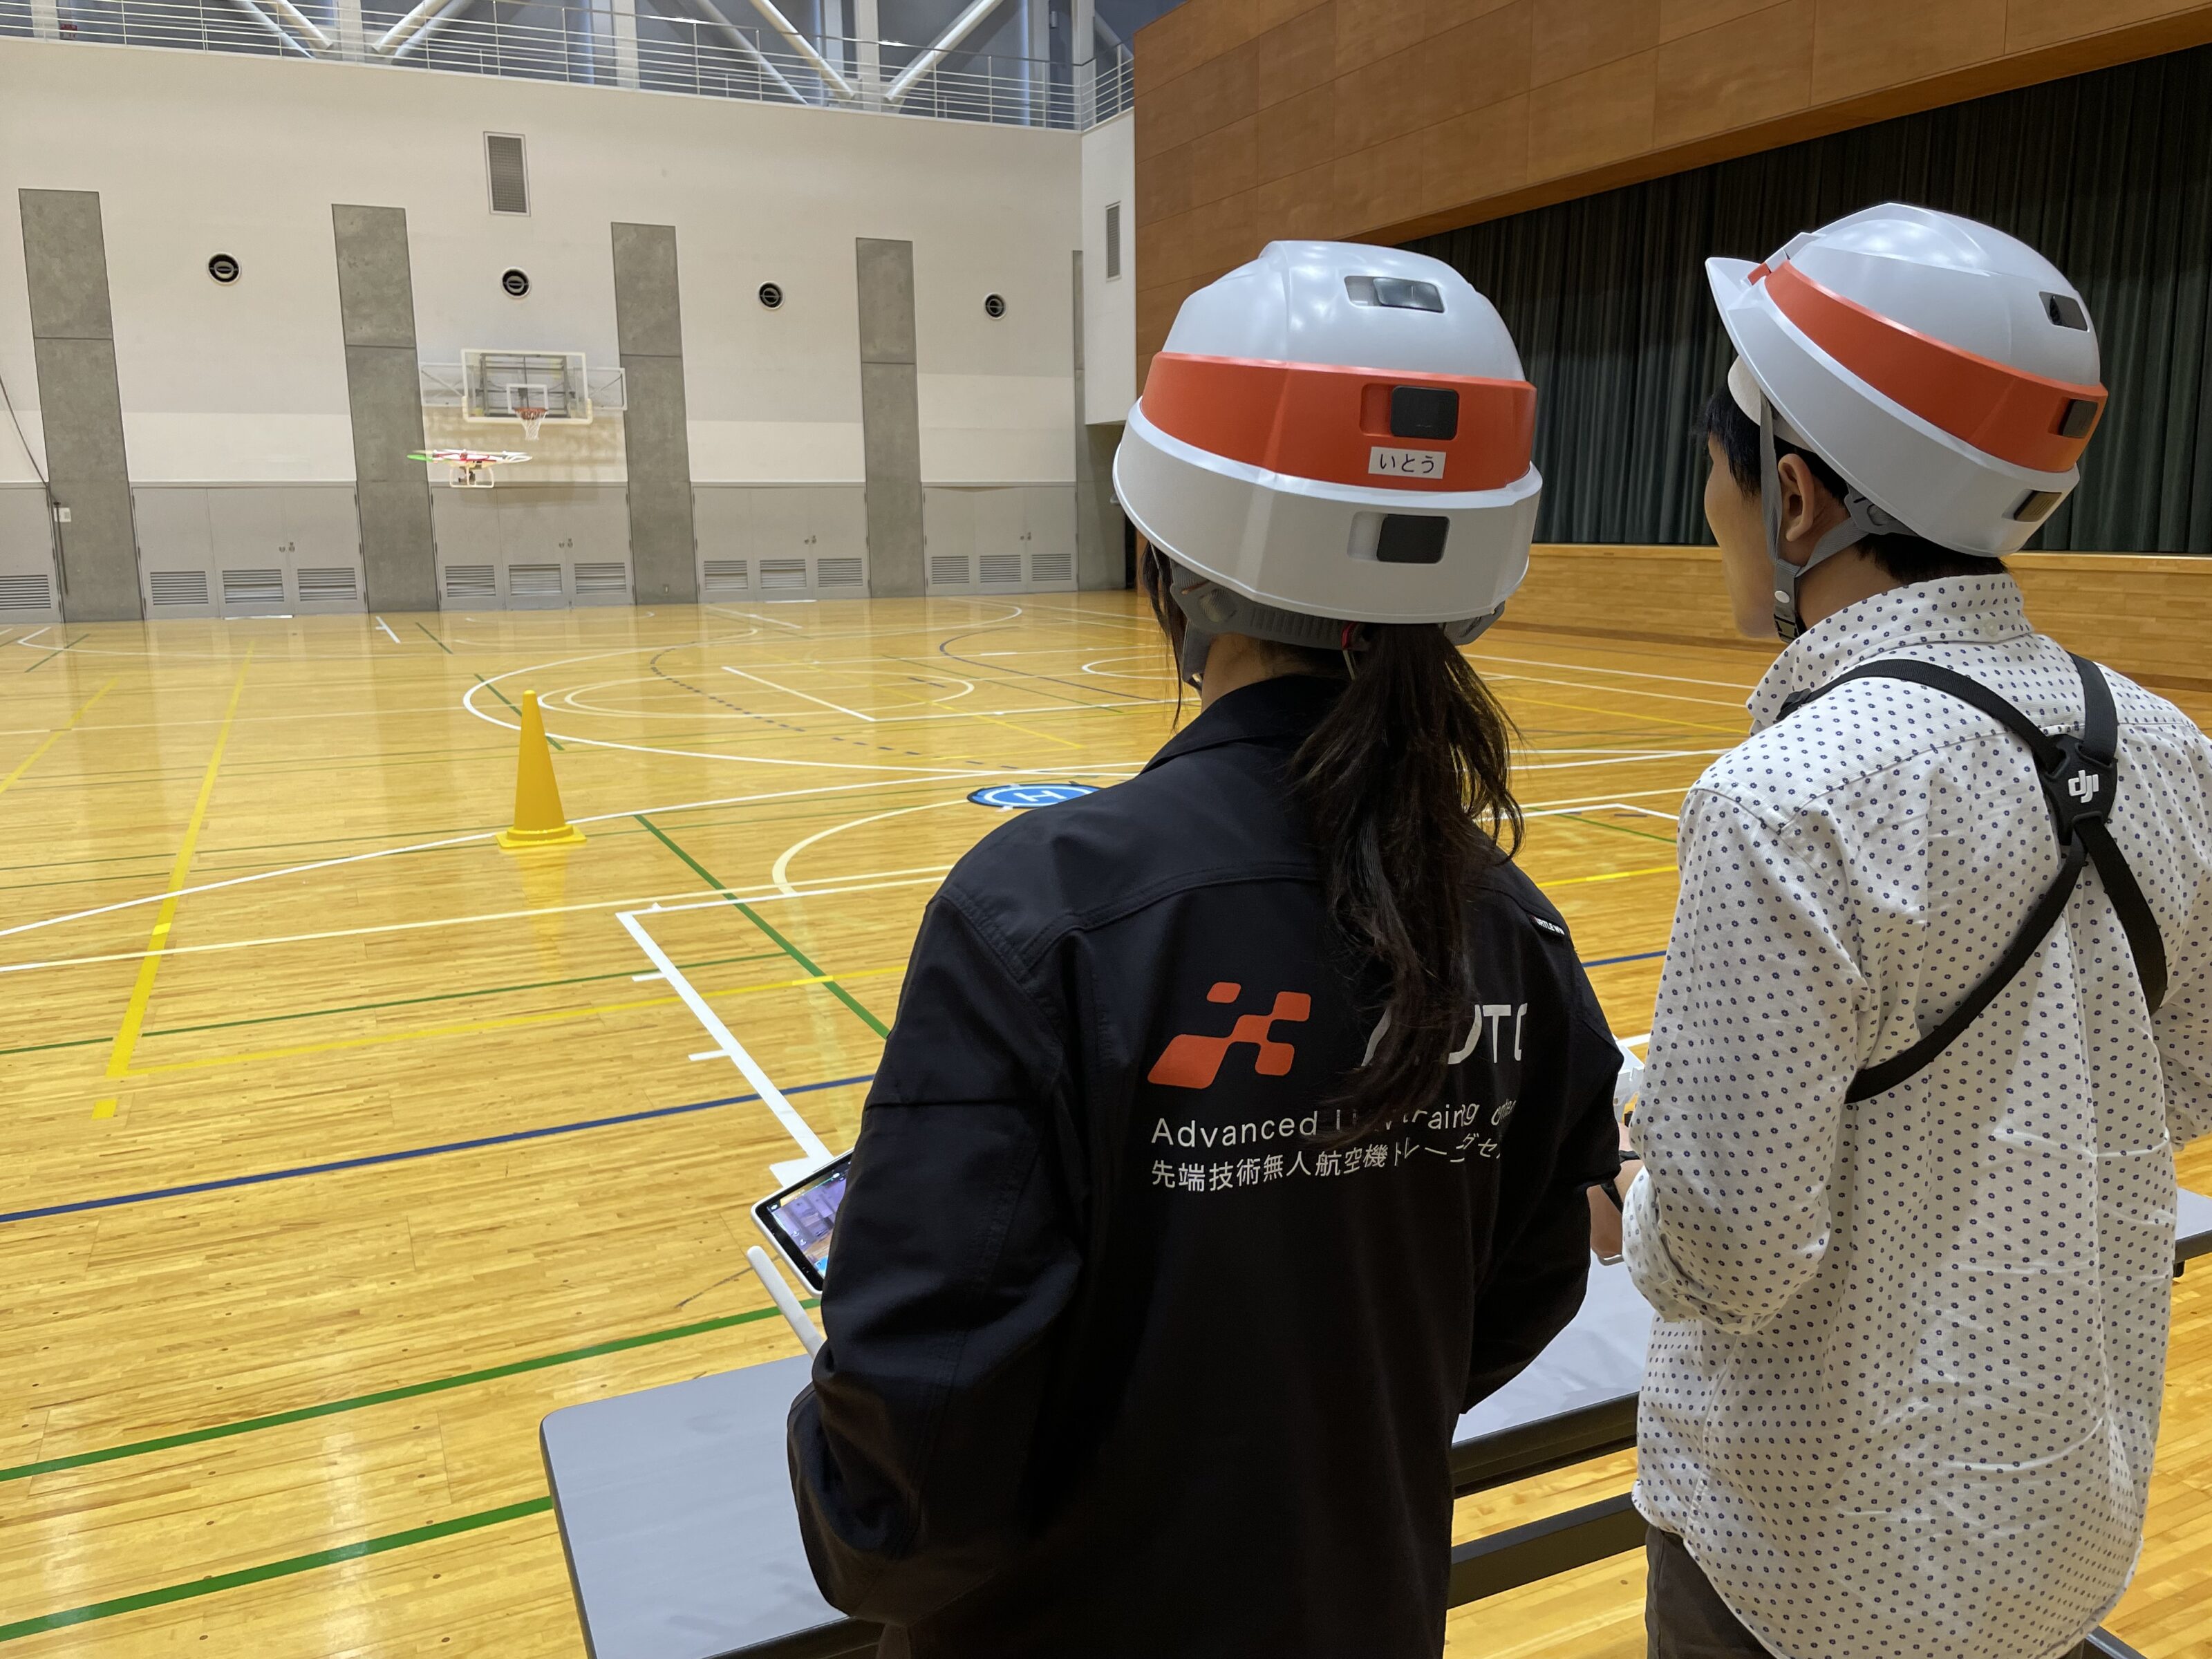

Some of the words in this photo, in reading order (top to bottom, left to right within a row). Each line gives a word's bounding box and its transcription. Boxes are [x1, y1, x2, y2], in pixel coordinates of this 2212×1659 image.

[1379, 453, 1435, 474] いとう
[1013, 790, 1067, 802] H
[2068, 769, 2099, 803] dji
[1151, 1110, 1318, 1148] Advanced
